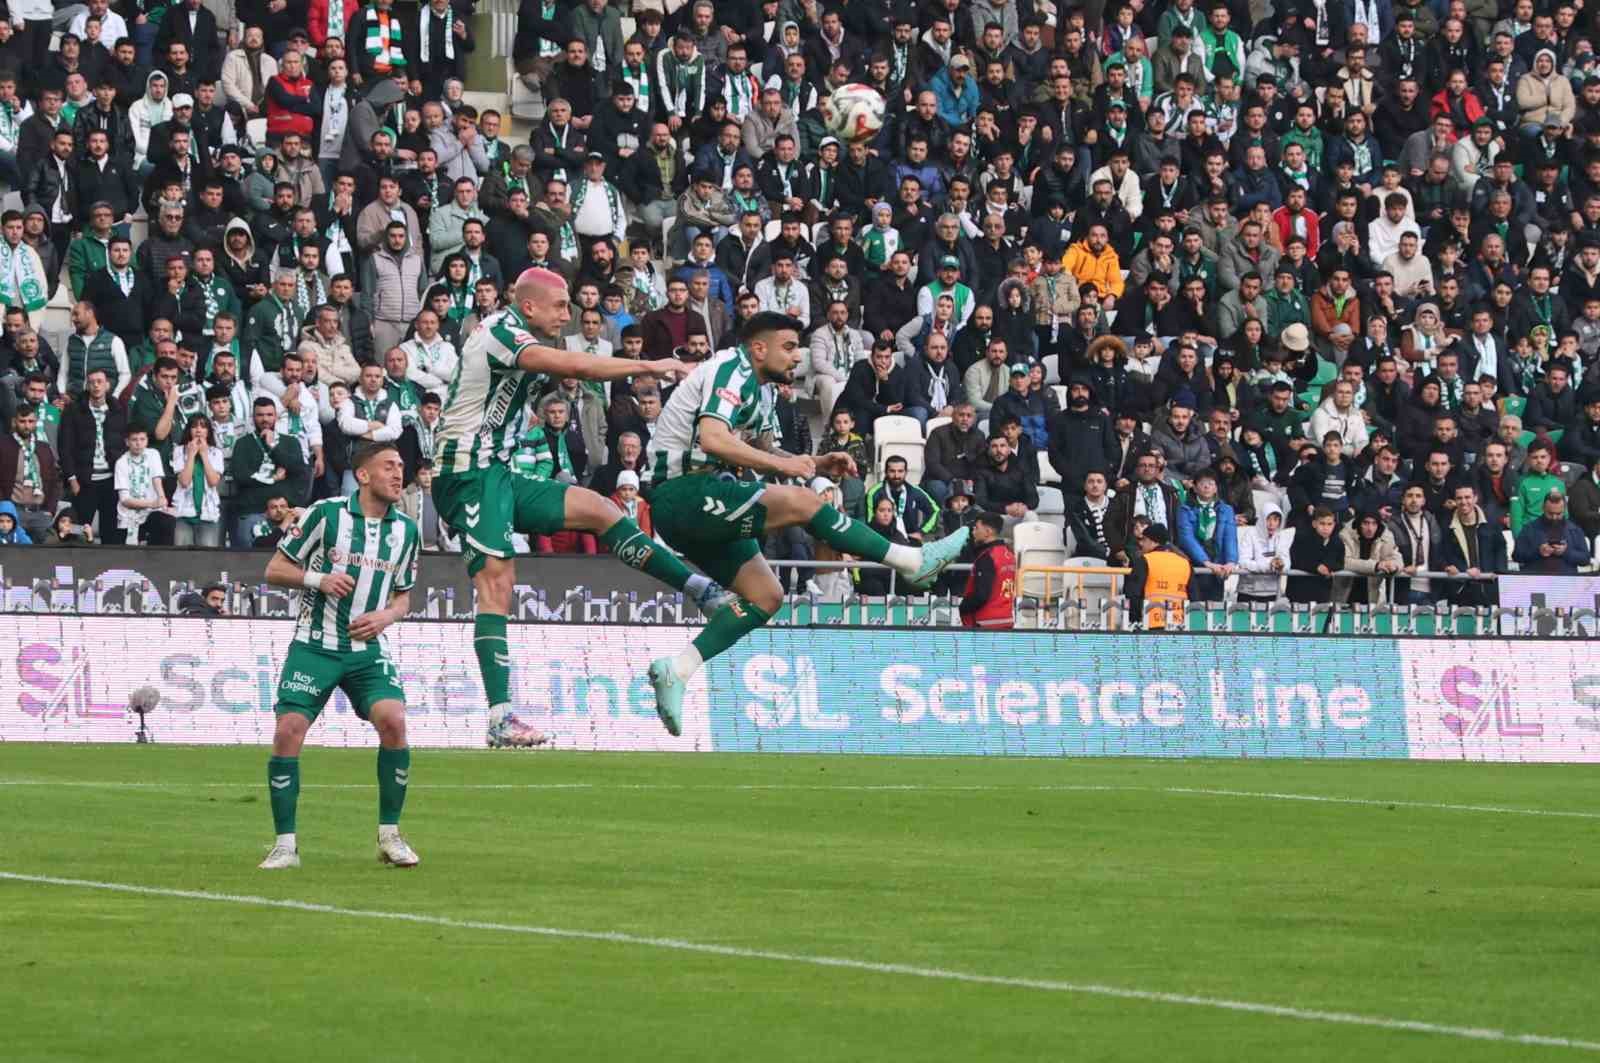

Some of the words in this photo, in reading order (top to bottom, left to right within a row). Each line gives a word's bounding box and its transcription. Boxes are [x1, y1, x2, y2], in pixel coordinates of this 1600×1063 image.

[292, 671, 315, 685] Rey
[743, 655, 850, 729] SL
[880, 664, 1186, 726] Science
[1209, 667, 1372, 729] Line
